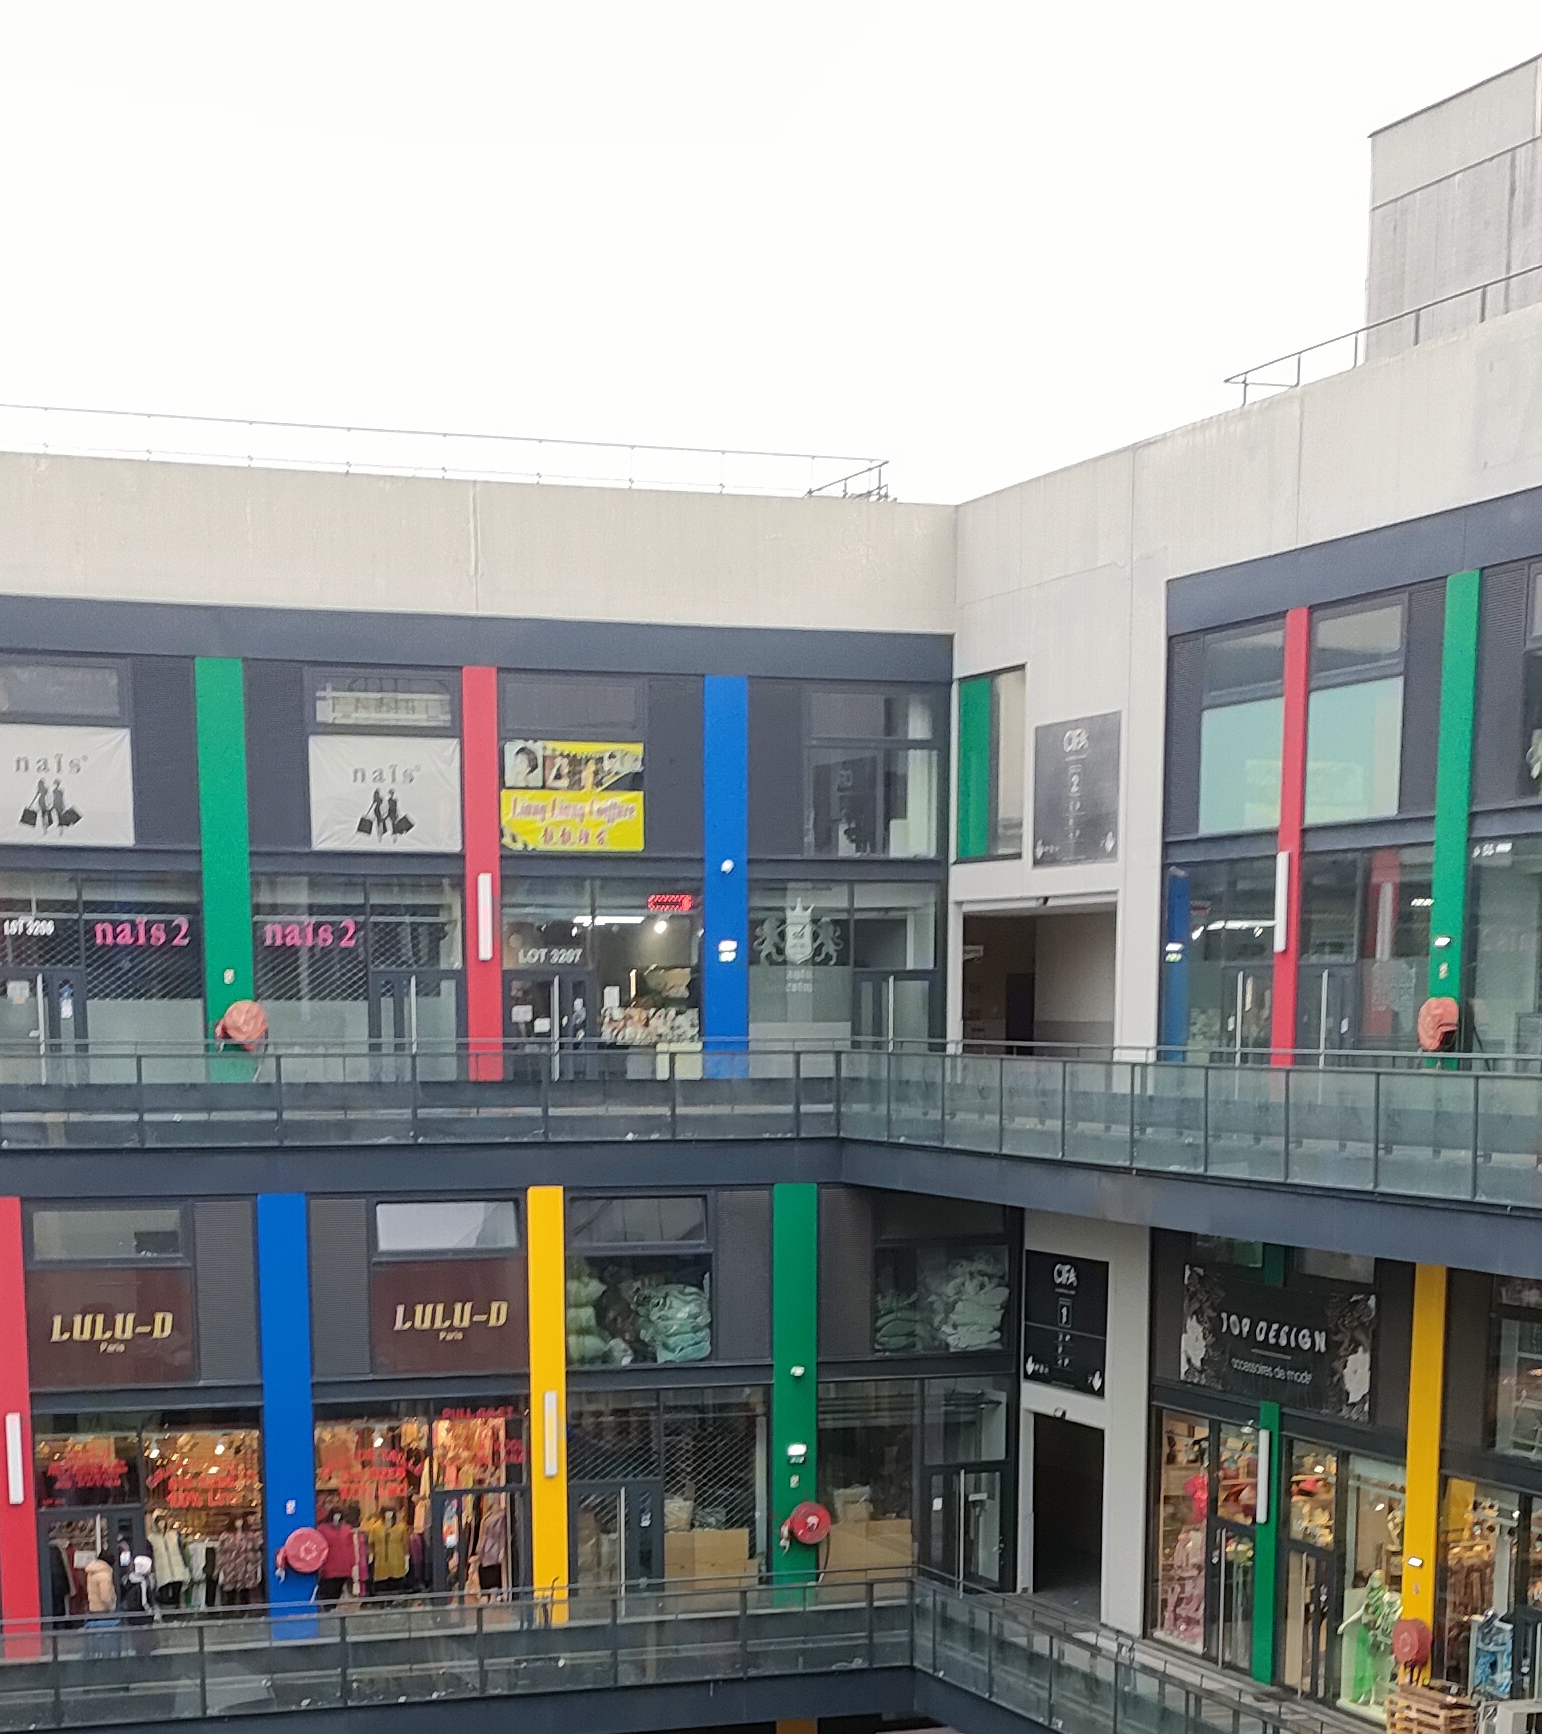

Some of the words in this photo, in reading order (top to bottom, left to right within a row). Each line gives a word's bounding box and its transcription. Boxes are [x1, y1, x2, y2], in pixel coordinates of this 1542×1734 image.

[95, 918, 166, 946] nais
[170, 918, 191, 946] 2
[264, 919, 333, 947] nais
[338, 919, 357, 947] 2
[518, 949, 546, 963] LOT
[50, 1311, 174, 1342] LULU-D
[394, 1301, 508, 1331] LULU-D
[1221, 1312, 1251, 1338] TOP
[1255, 1321, 1326, 1353] DESIGN
[1274, 1365, 1285, 1380] de
[1287, 1369, 1312, 1385] mode
